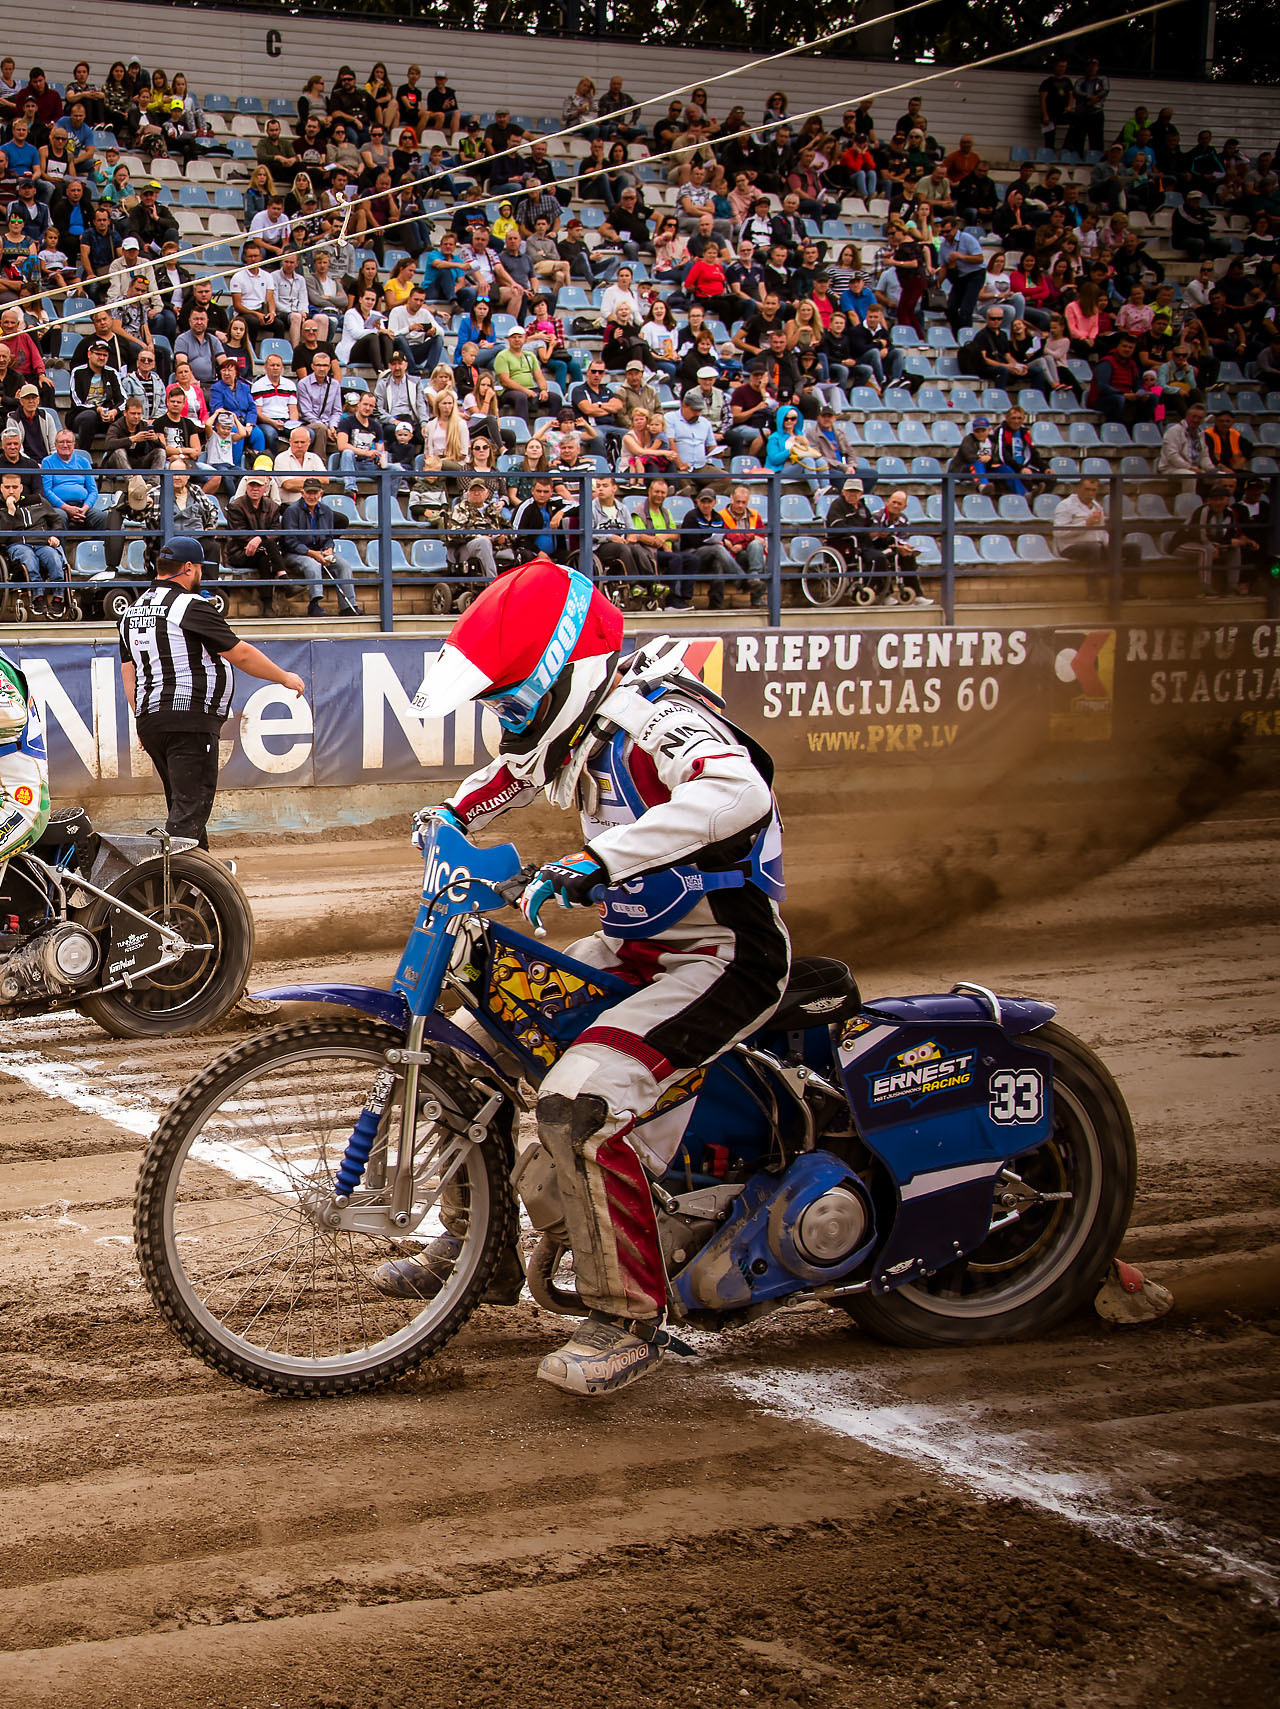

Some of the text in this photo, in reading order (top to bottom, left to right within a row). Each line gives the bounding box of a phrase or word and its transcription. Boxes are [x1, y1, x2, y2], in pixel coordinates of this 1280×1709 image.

[266, 29, 282, 57] C
[271, 341, 280, 349] 14
[332, 498, 342, 506] 12
[735, 630, 1027, 672] RIEPU CENTRS
[1126, 626, 1239, 662] RIEPU
[763, 676, 1000, 718] STACIJAS 60
[1149, 668, 1280, 705] STACIJA
[465, 781, 522, 821] MALINIAK
[873, 1055, 972, 1096] ERNEST
[921, 1073, 971, 1094] RACING
[990, 1070, 1042, 1124] 33
